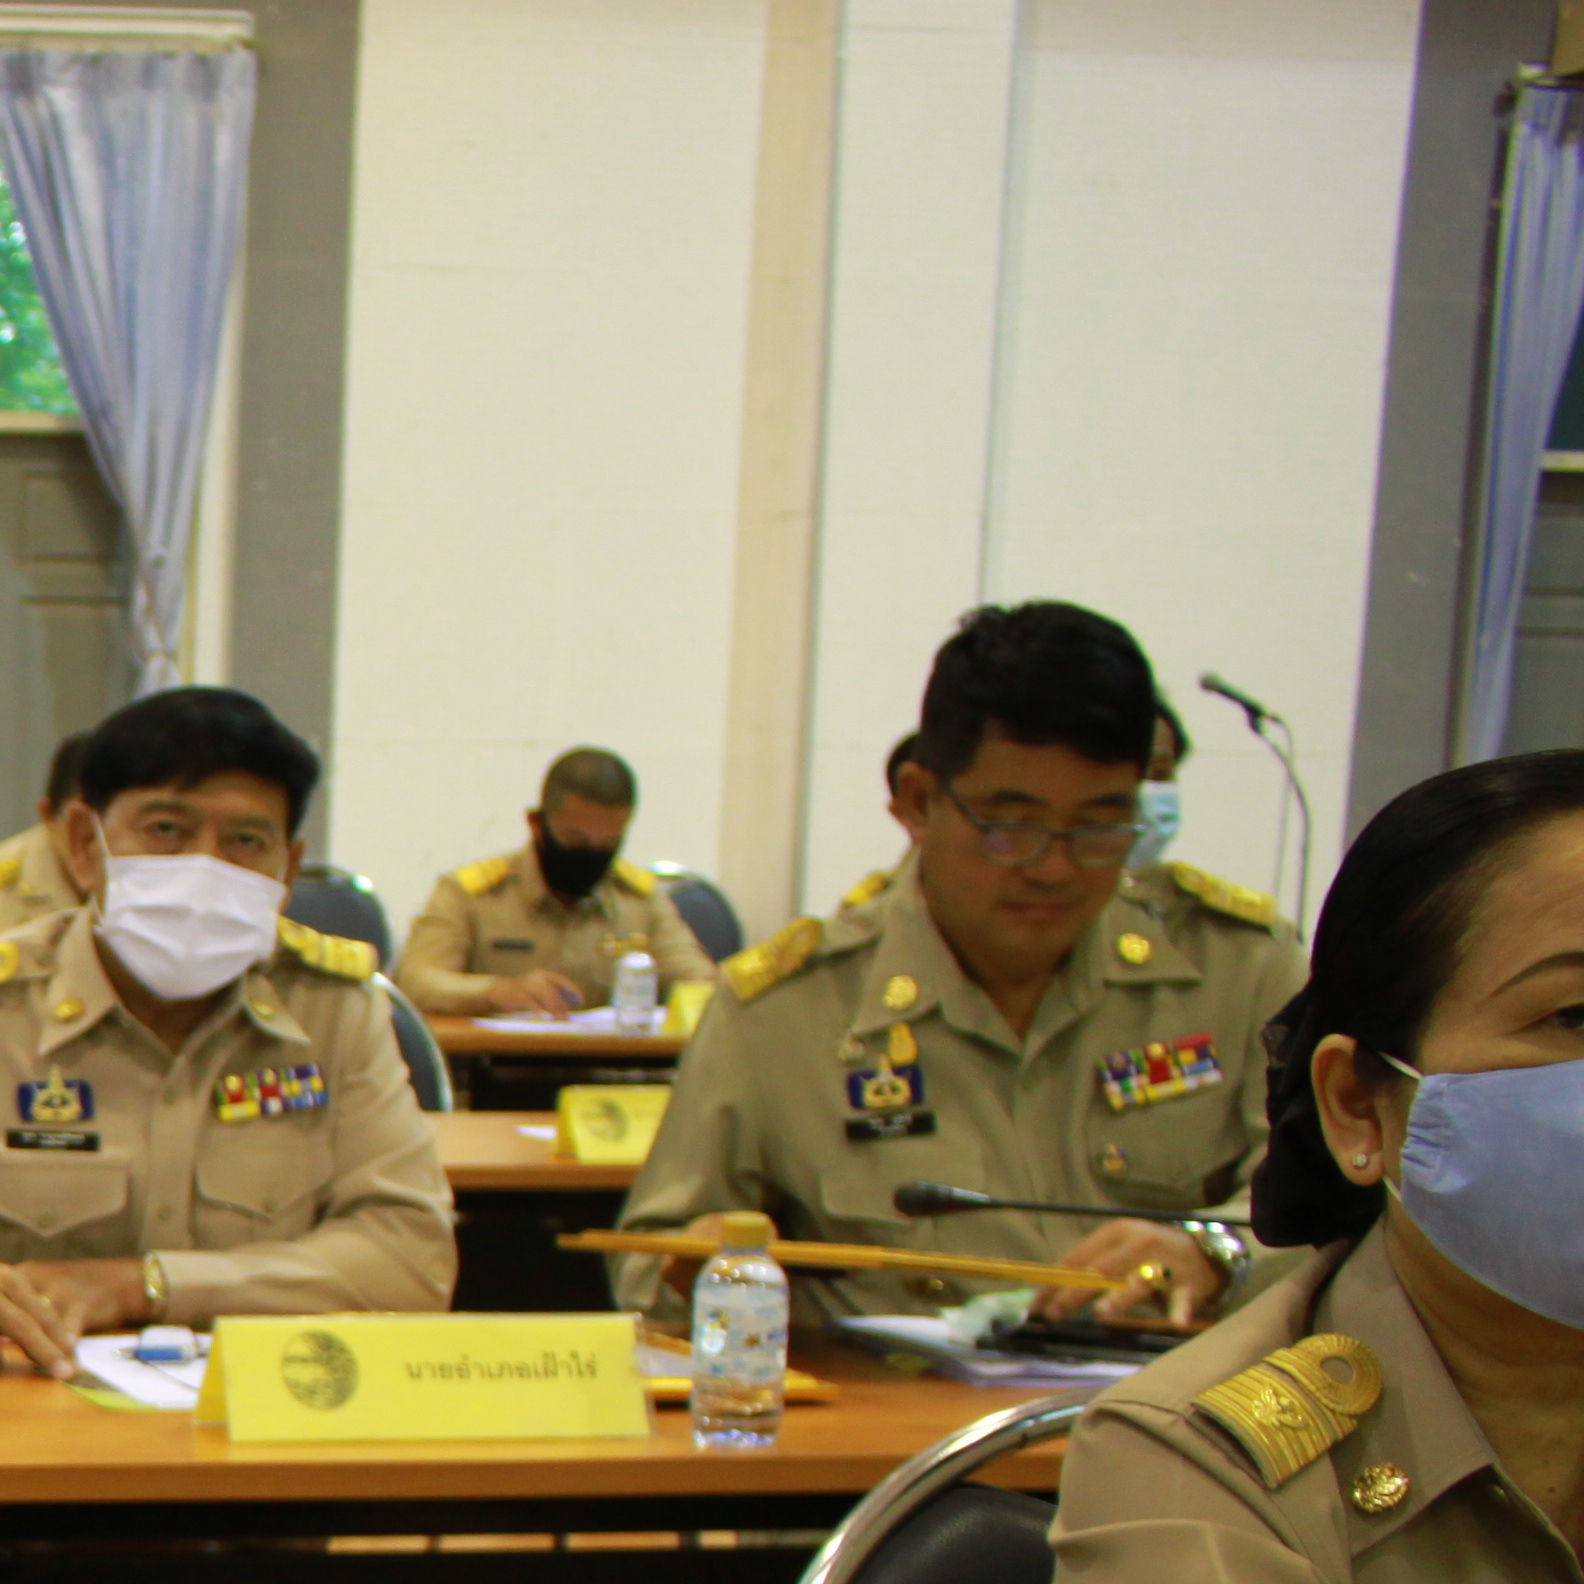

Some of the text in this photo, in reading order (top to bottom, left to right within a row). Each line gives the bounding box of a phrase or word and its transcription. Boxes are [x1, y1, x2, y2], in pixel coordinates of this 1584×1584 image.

[405, 1351, 598, 1381] นายอำเภอเฝ้าไร่
